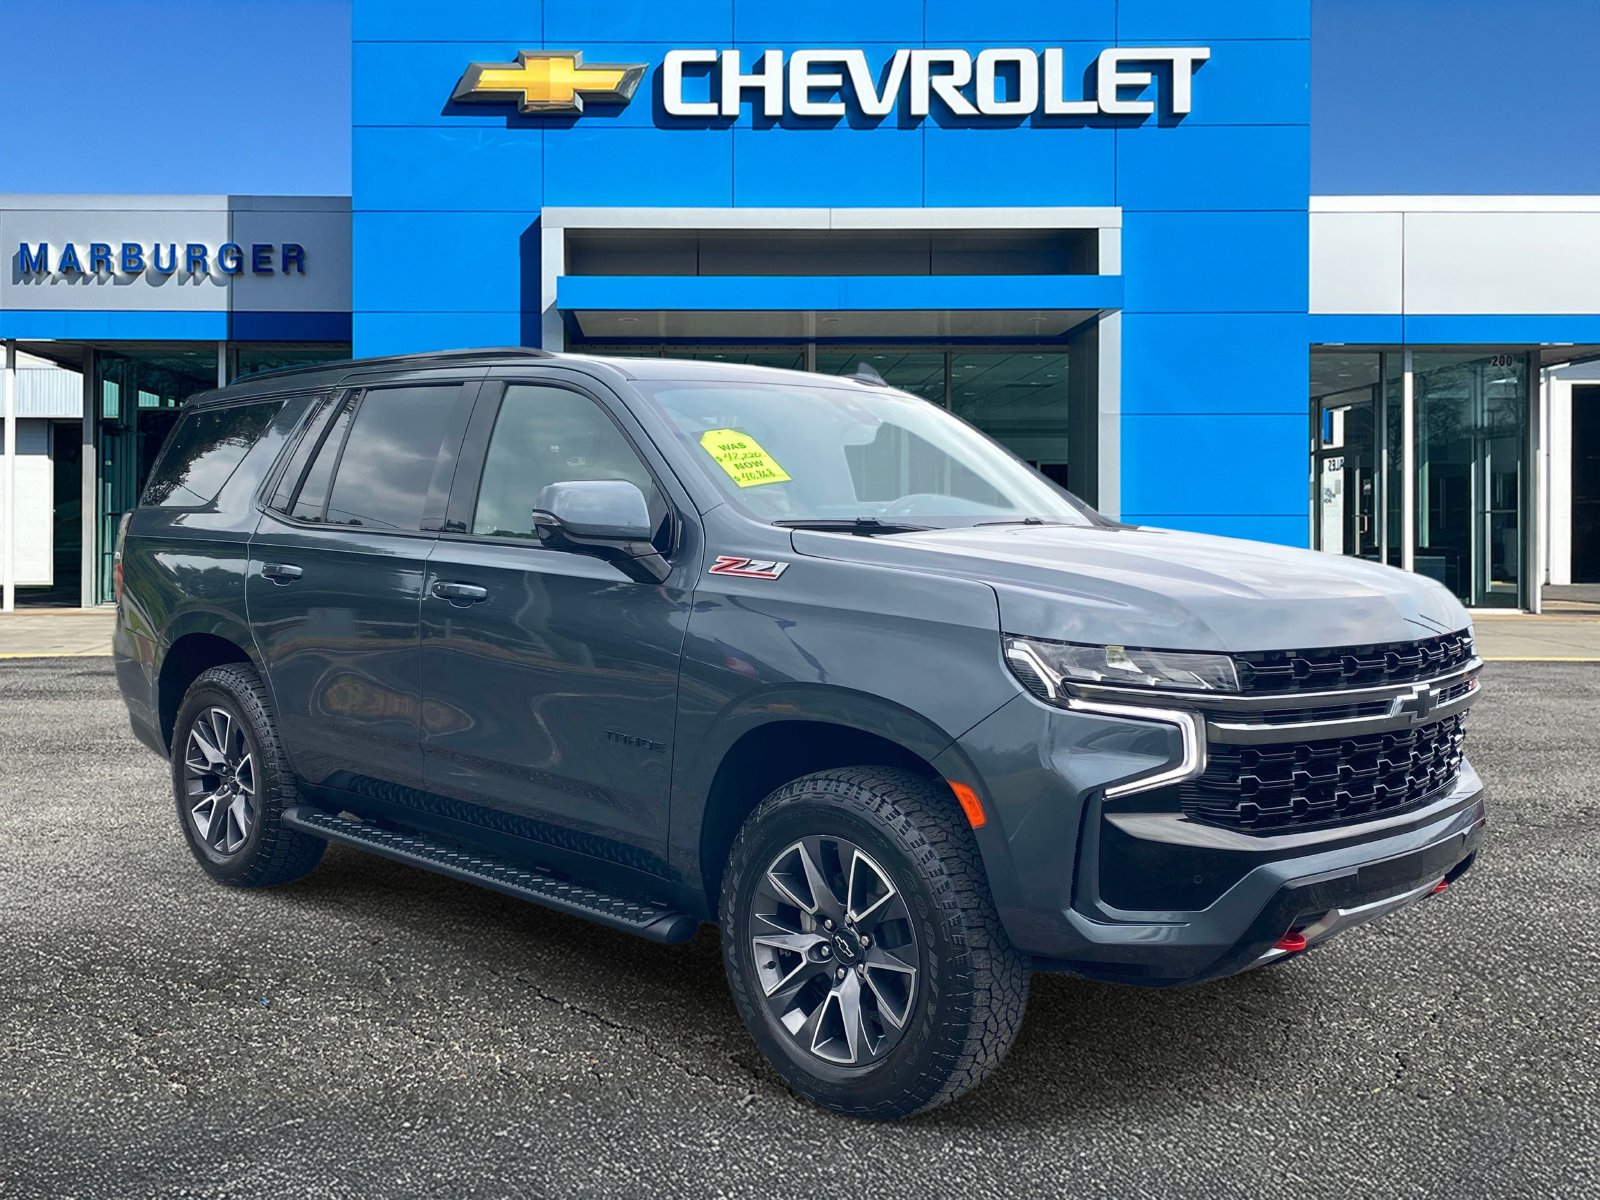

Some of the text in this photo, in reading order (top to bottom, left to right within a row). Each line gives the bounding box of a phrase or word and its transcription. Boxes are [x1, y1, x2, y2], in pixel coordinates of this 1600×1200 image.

[663, 46, 1211, 116] CHEVROLET
[18, 241, 306, 275] MARBURGER
[1491, 354, 1513, 367] 200
[718, 442, 747, 452] WAS
[733, 459, 764, 471] NOW
